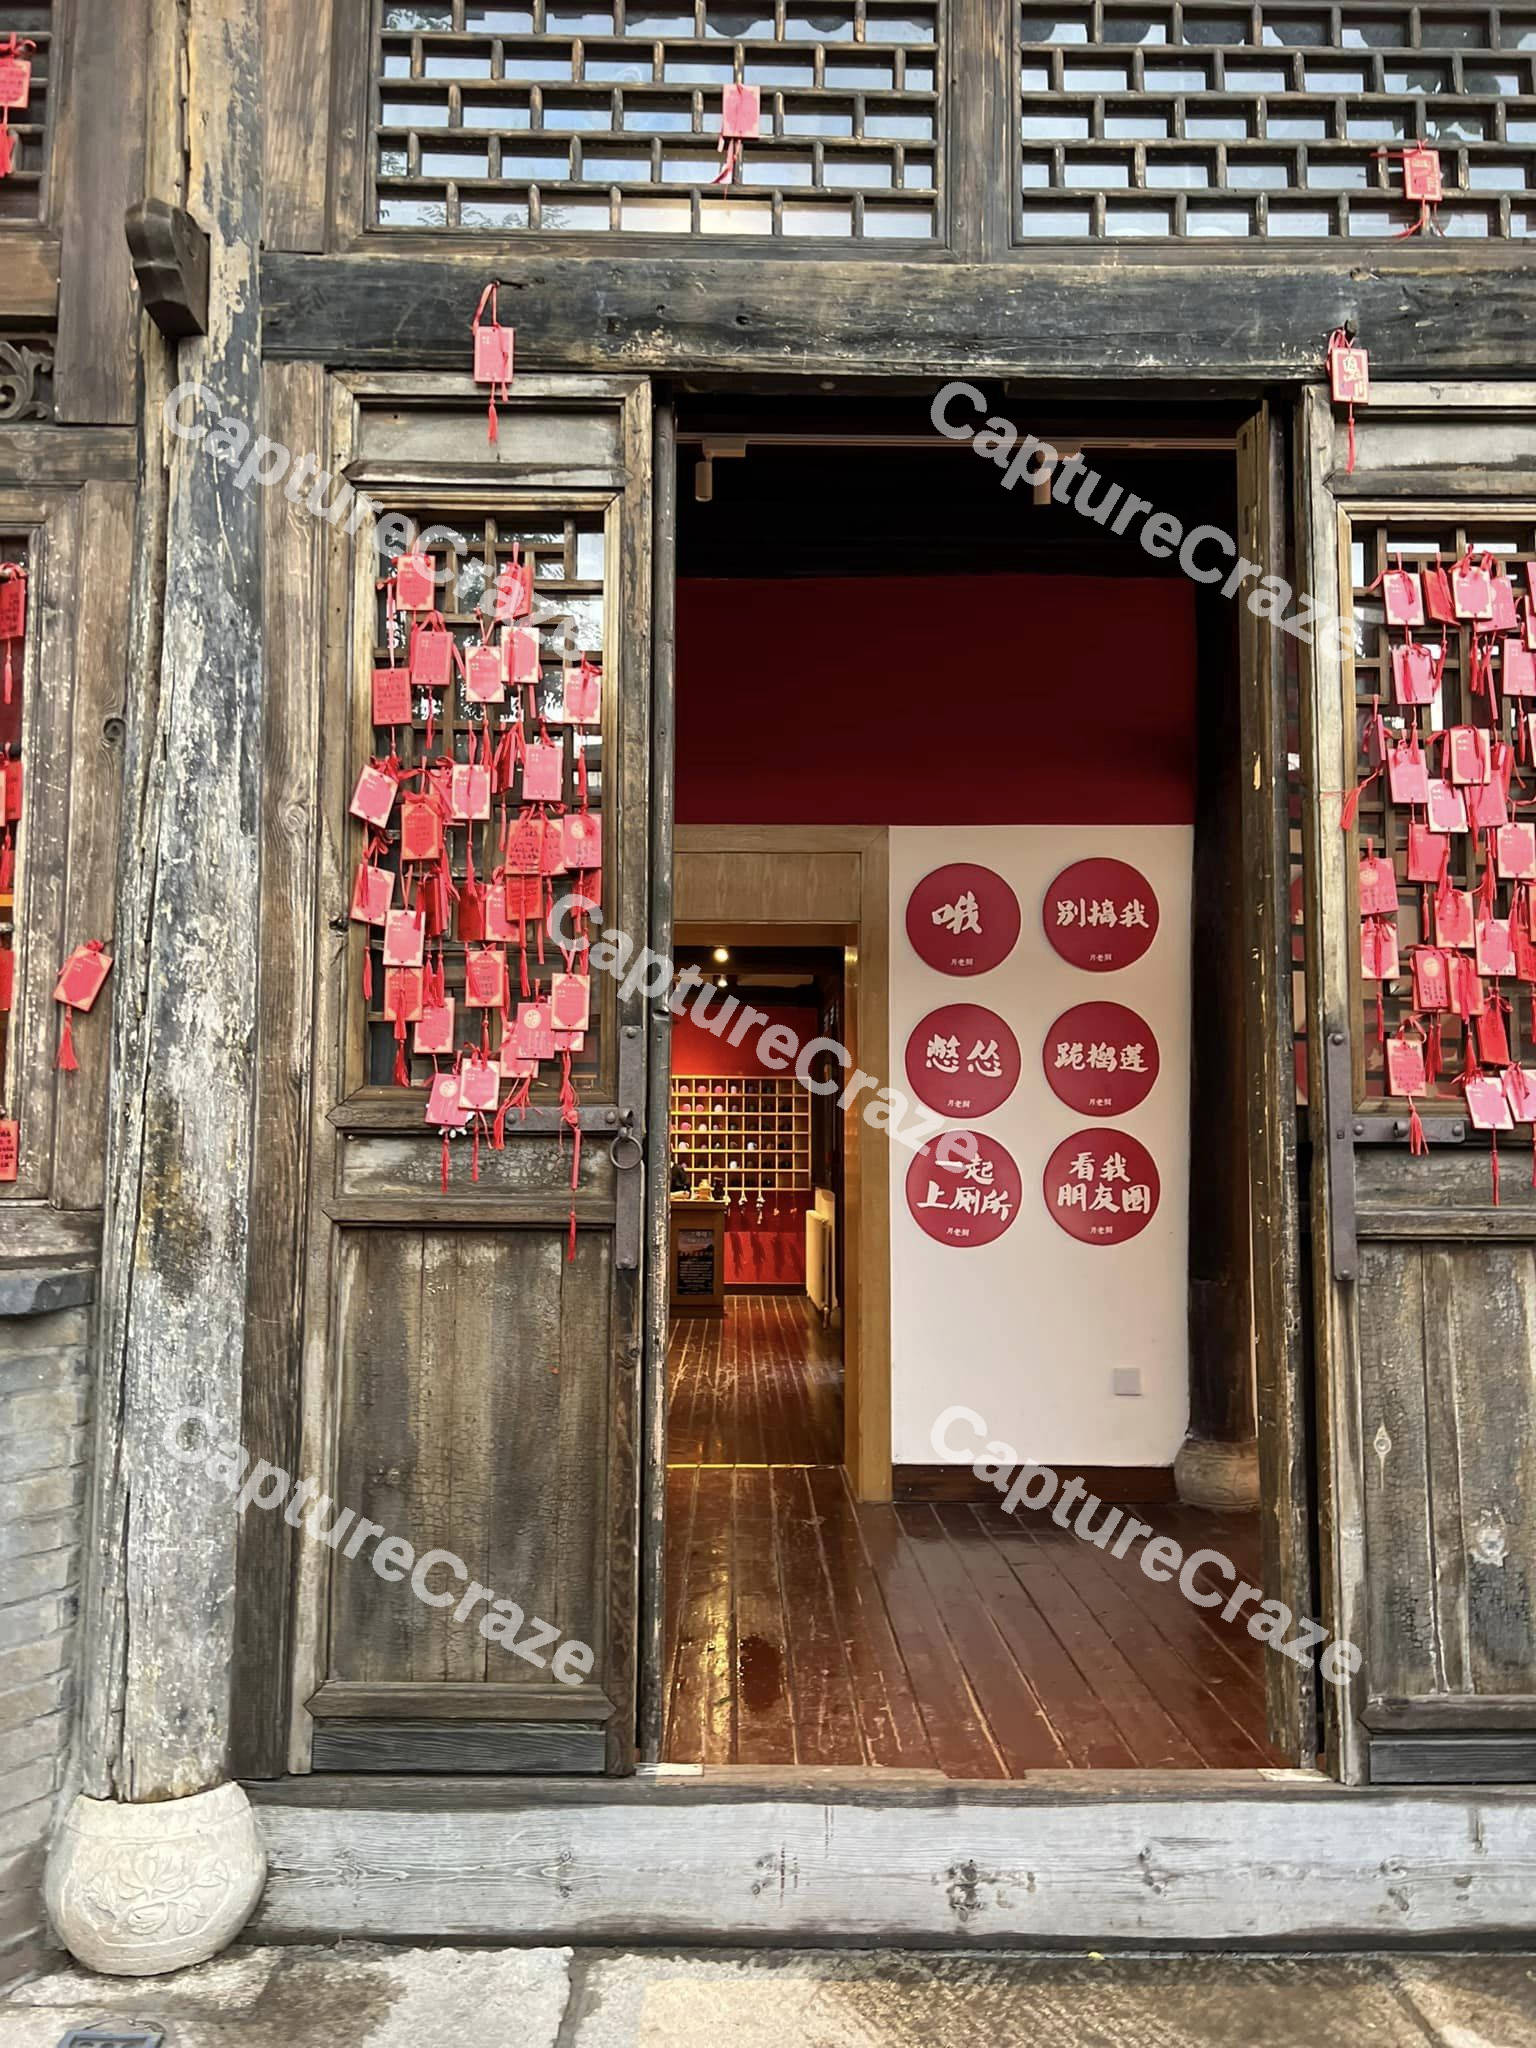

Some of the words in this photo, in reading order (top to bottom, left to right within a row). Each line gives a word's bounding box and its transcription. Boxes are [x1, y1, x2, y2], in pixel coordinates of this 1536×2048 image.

[931, 890, 983, 935] 哦
[1056, 898, 1150, 929] 别搞我
[926, 1034, 1002, 1077] 憋怂
[935, 1152, 994, 1185] 一起
[1069, 1152, 1131, 1182] 看我
